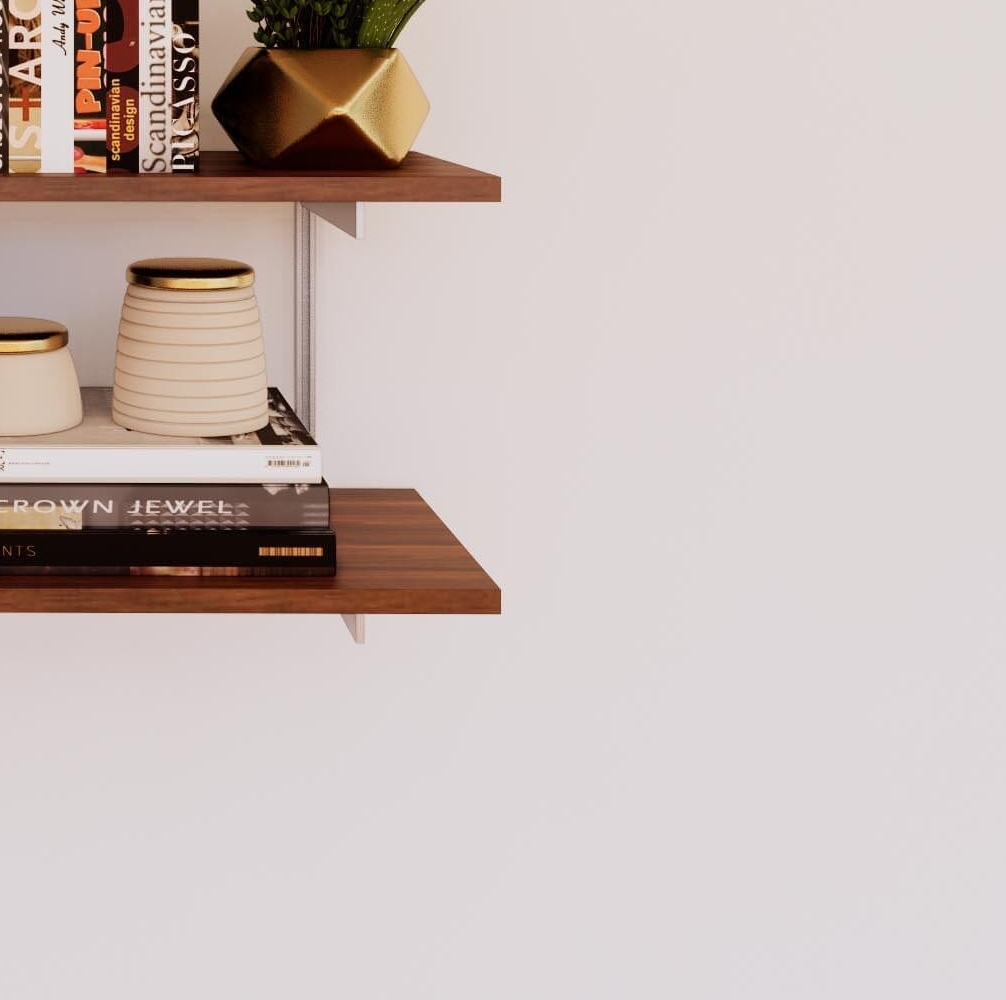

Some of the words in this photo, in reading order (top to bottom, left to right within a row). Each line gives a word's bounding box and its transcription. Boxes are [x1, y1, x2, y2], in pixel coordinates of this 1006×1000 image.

[53, 21, 69, 57] Andy
[111, 78, 121, 161] scandinavian
[123, 98, 138, 142] design
[172, 32, 195, 171] PICASSO
[127, 499, 233, 514] JEWEL
